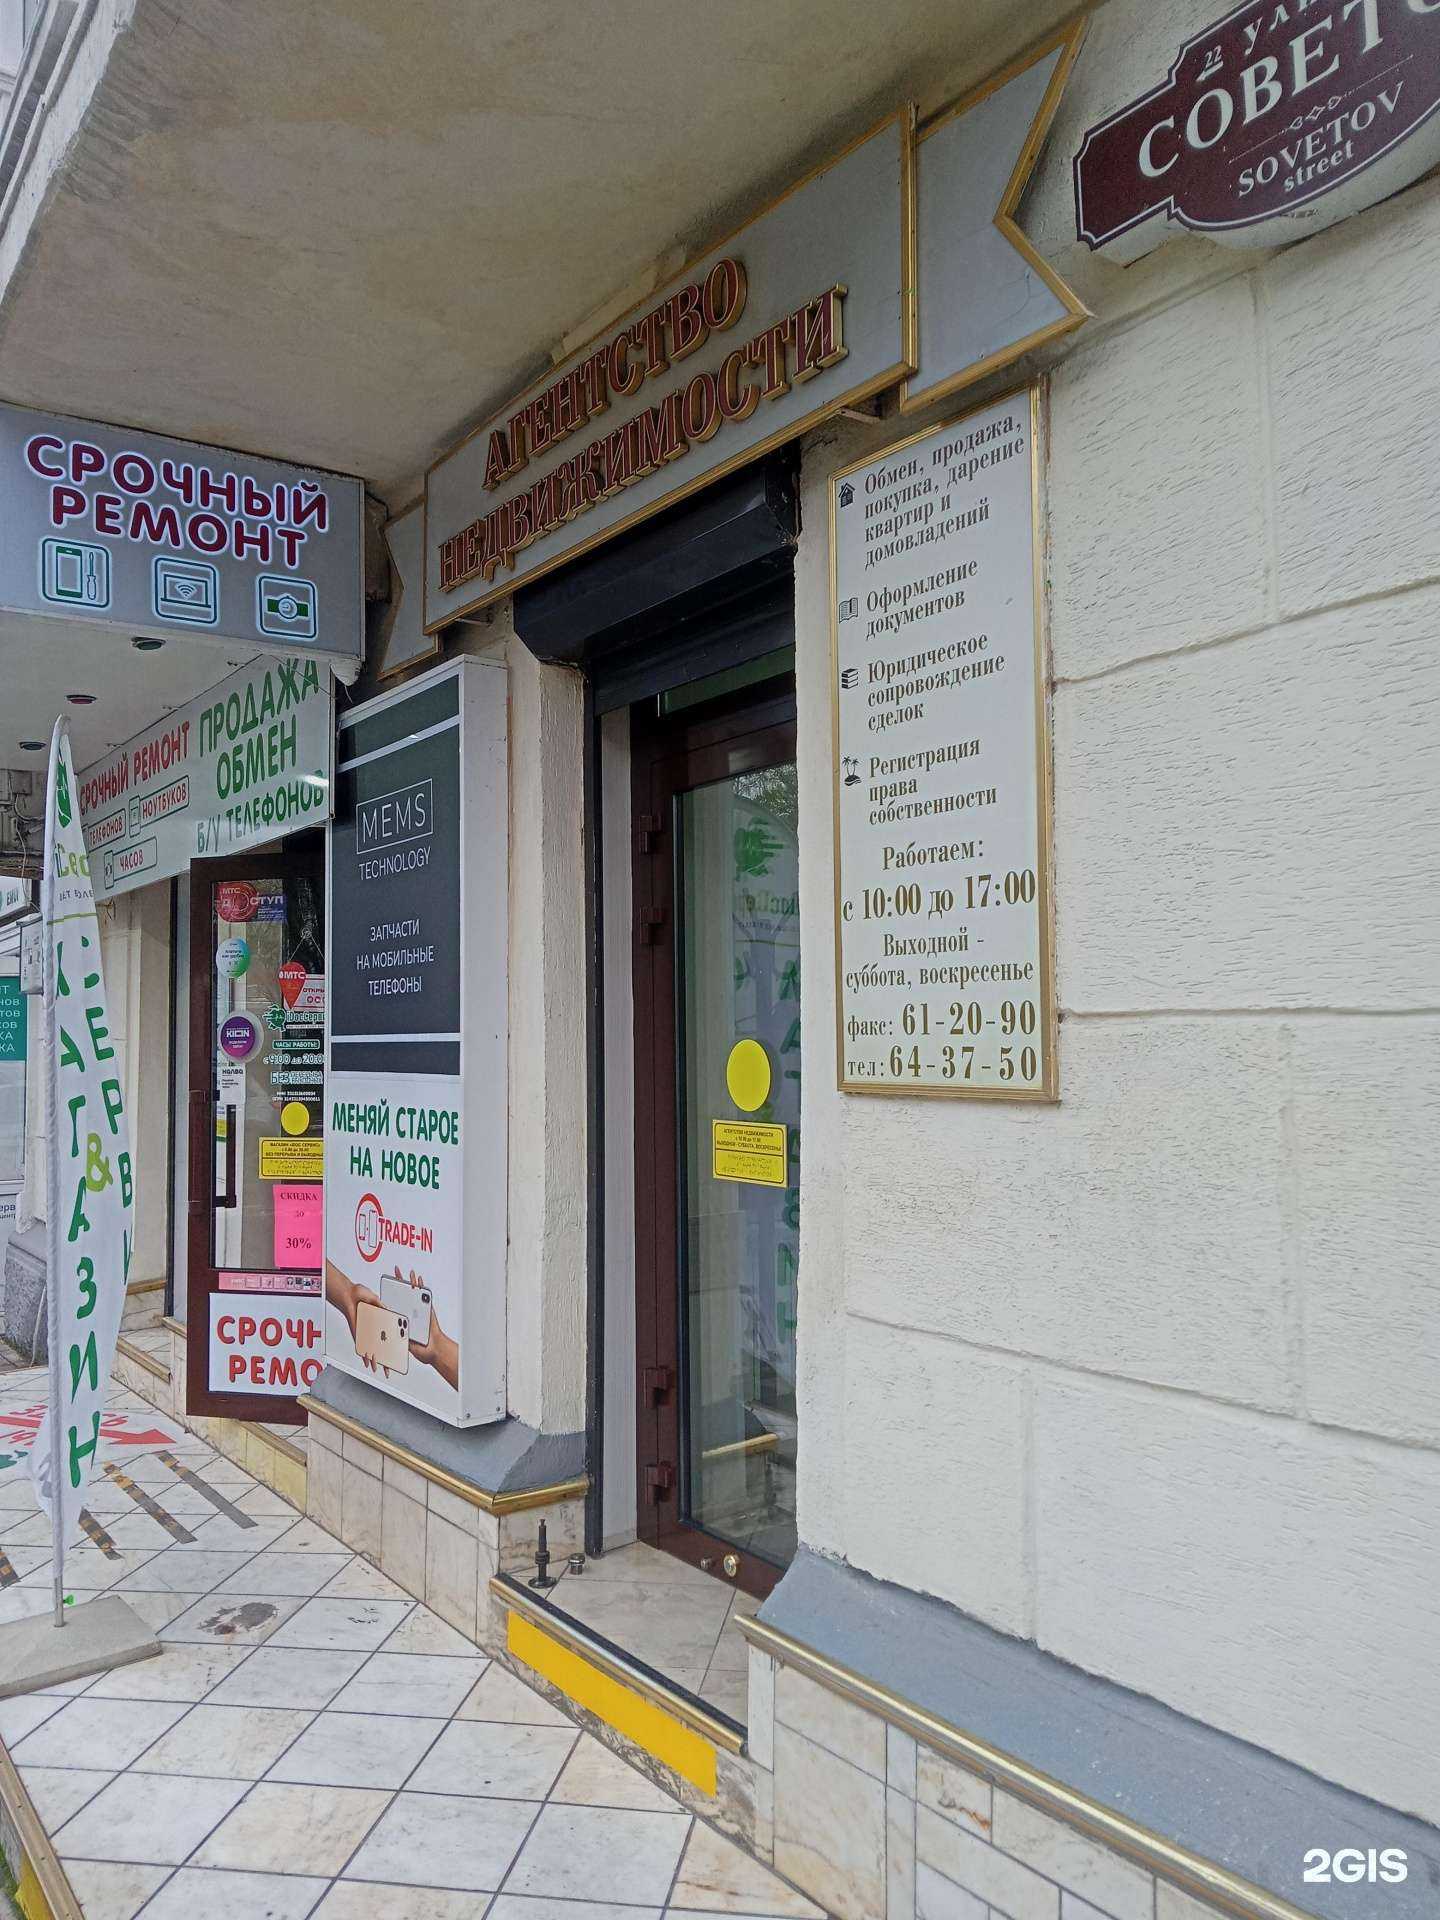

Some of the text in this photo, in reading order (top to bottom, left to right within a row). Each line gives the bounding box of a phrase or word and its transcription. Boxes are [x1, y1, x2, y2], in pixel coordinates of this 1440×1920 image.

[1243, 0, 1317, 56] ул
[1203, 45, 1223, 69] 22
[1139, 0, 1440, 178] СОВЕТ
[1238, 81, 1404, 198] SOVETOV
[1284, 141, 1354, 193] street
[482, 258, 747, 490] АГЕНТСТВО
[438, 281, 848, 592] НЕДВИЖИМОСТИ
[865, 415, 1022, 494] Обмен, продажа,
[27, 436, 327, 530] СРОЧНЫЙ
[865, 437, 1025, 519] покупка, дарение
[53, 486, 305, 566] РЕМОНТ
[865, 494, 951, 543] квартир и
[865, 498, 990, 570] домовладений
[866, 559, 978, 613] Оформление
[866, 589, 965, 641] документов
[868, 633, 988, 683] Юридическое
[868, 655, 1005, 707] сопровождение
[200, 658, 319, 757] ПРОДАЖА
[868, 702, 924, 732] сделок
[80, 721, 189, 816] СРОЧНЫЙ РЕМОНТ
[216, 714, 296, 800] ОБМЕН
[869, 738, 981, 778] Регистрация
[142, 783, 187, 818] НОУТБУКОВ
[197, 769, 324, 853] Б/У ТЕЛЕФОНОВ
[869, 777, 918, 803] права
[869, 786, 997, 825] собственности
[90, 816, 123, 846] ТЕЛЕФОНОВ
[363, 792, 426, 843] MEMS
[120, 849, 143, 872] ЧАСОВ
[359, 846, 431, 881] TECHNOLOGY
[882, 839, 984, 871] Работаем:
[843, 869, 1036, 921] с 10:00 до 17:00
[370, 919, 420, 942] ЗАПЧАСТИ
[883, 926, 969, 958] Выходной
[357, 945, 434, 971] НА МОБИЛЬНЫЕ
[846, 959, 1034, 993] суббота, воскресенье
[368, 976, 422, 996] ТЕЛЕФОНЫ
[848, 1000, 1036, 1041] факс: 61-20-90
[848, 1045, 1037, 1081] тел: 64-37-50
[332, 1099, 459, 1145] МЕНЯЙ СТАРОЕ
[350, 1146, 440, 1190] НА НОВОЕ
[280, 1192, 319, 1200] СКИДКА
[286, 1237, 312, 1249] 30%
[378, 1217, 433, 1253] TRADE-IN
[217, 1316, 322, 1348] СРОЧН
[229, 1355, 323, 1387] РЕМО
